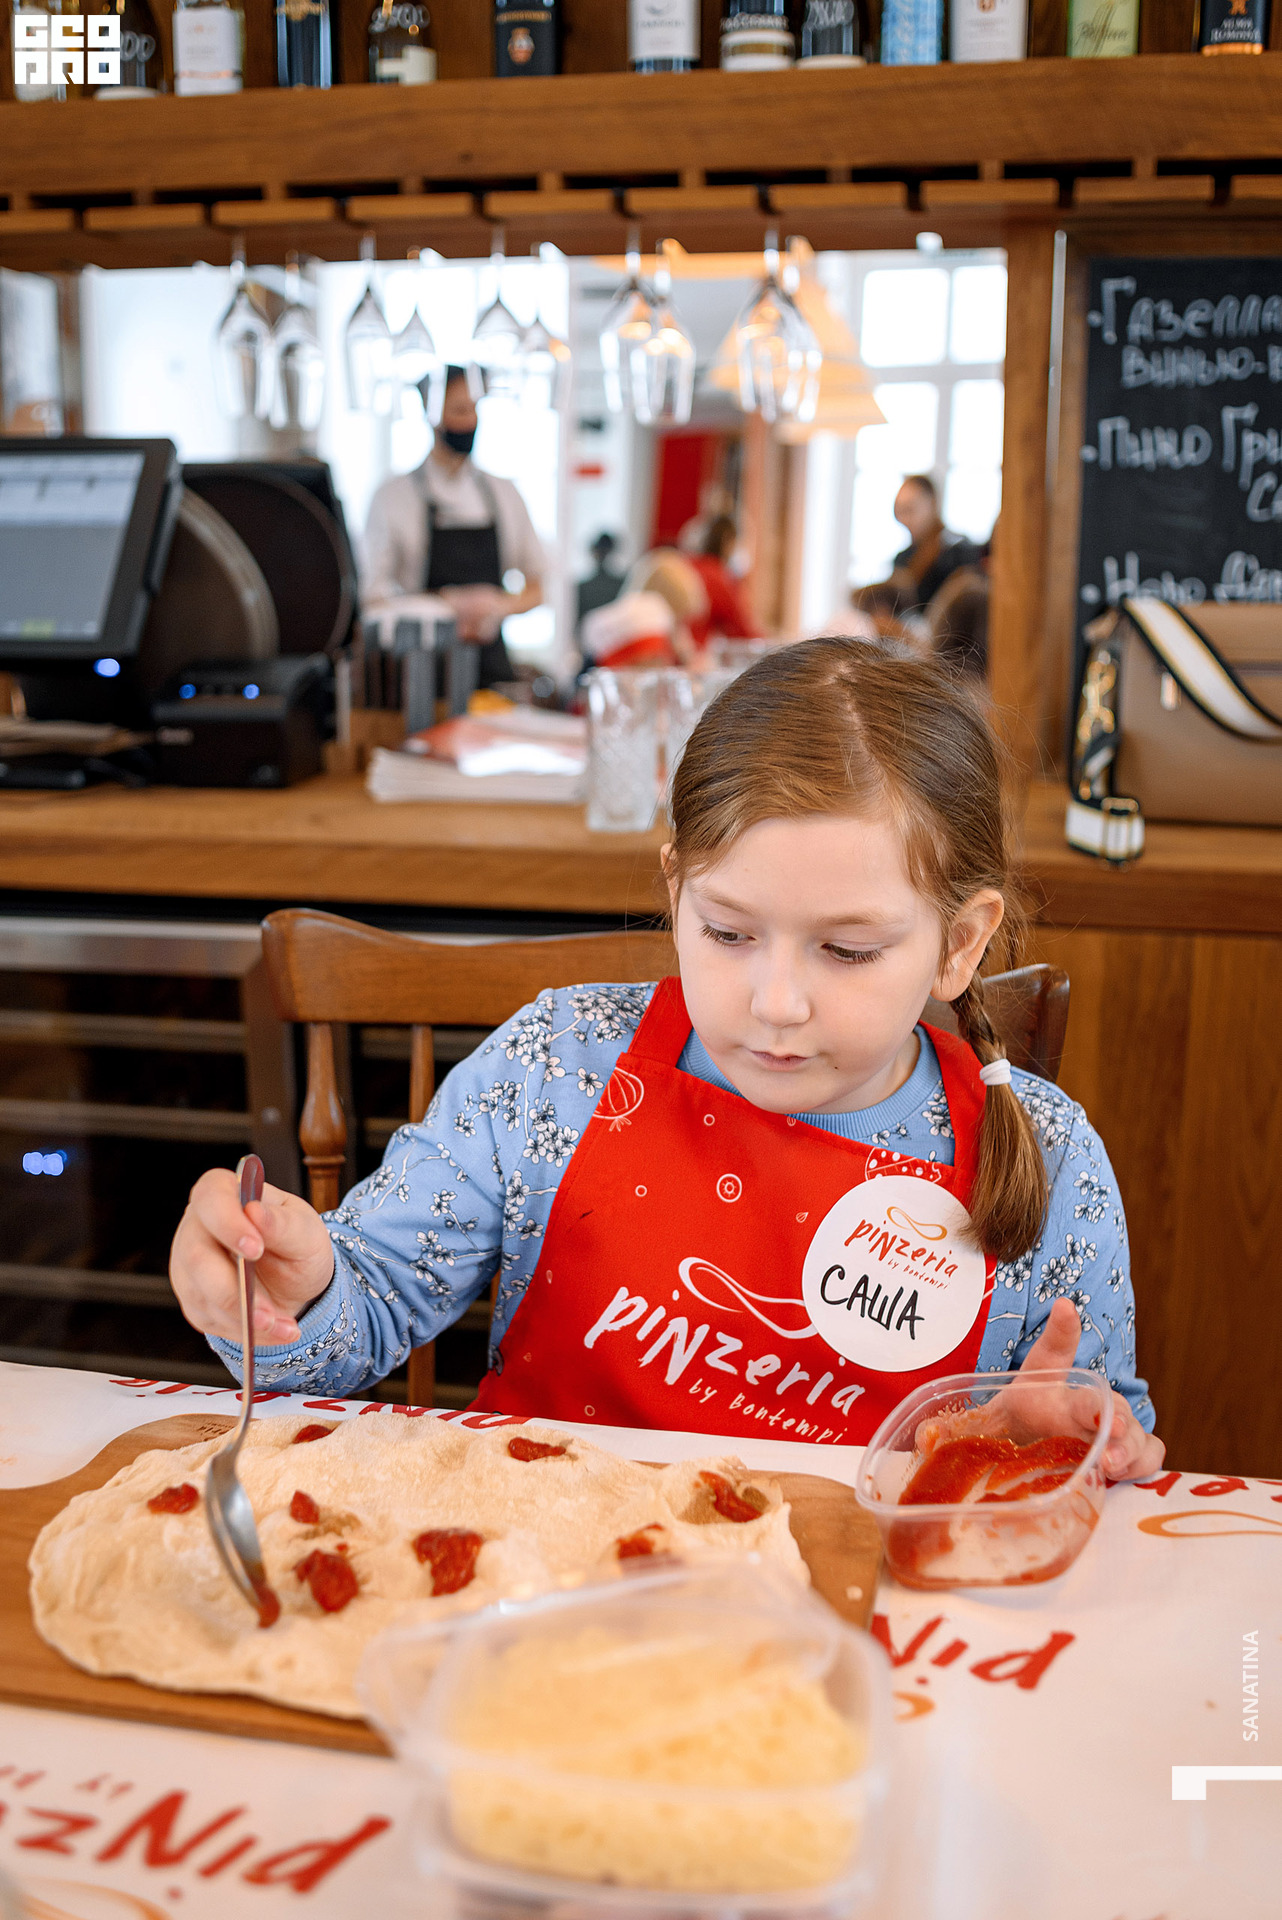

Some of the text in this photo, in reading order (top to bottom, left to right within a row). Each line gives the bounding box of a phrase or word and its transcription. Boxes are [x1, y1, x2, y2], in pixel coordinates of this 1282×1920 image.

[887, 1258, 899, 1270] by
[820, 1264, 926, 1340] САША
[689, 1378, 849, 1443] by Bontempi
